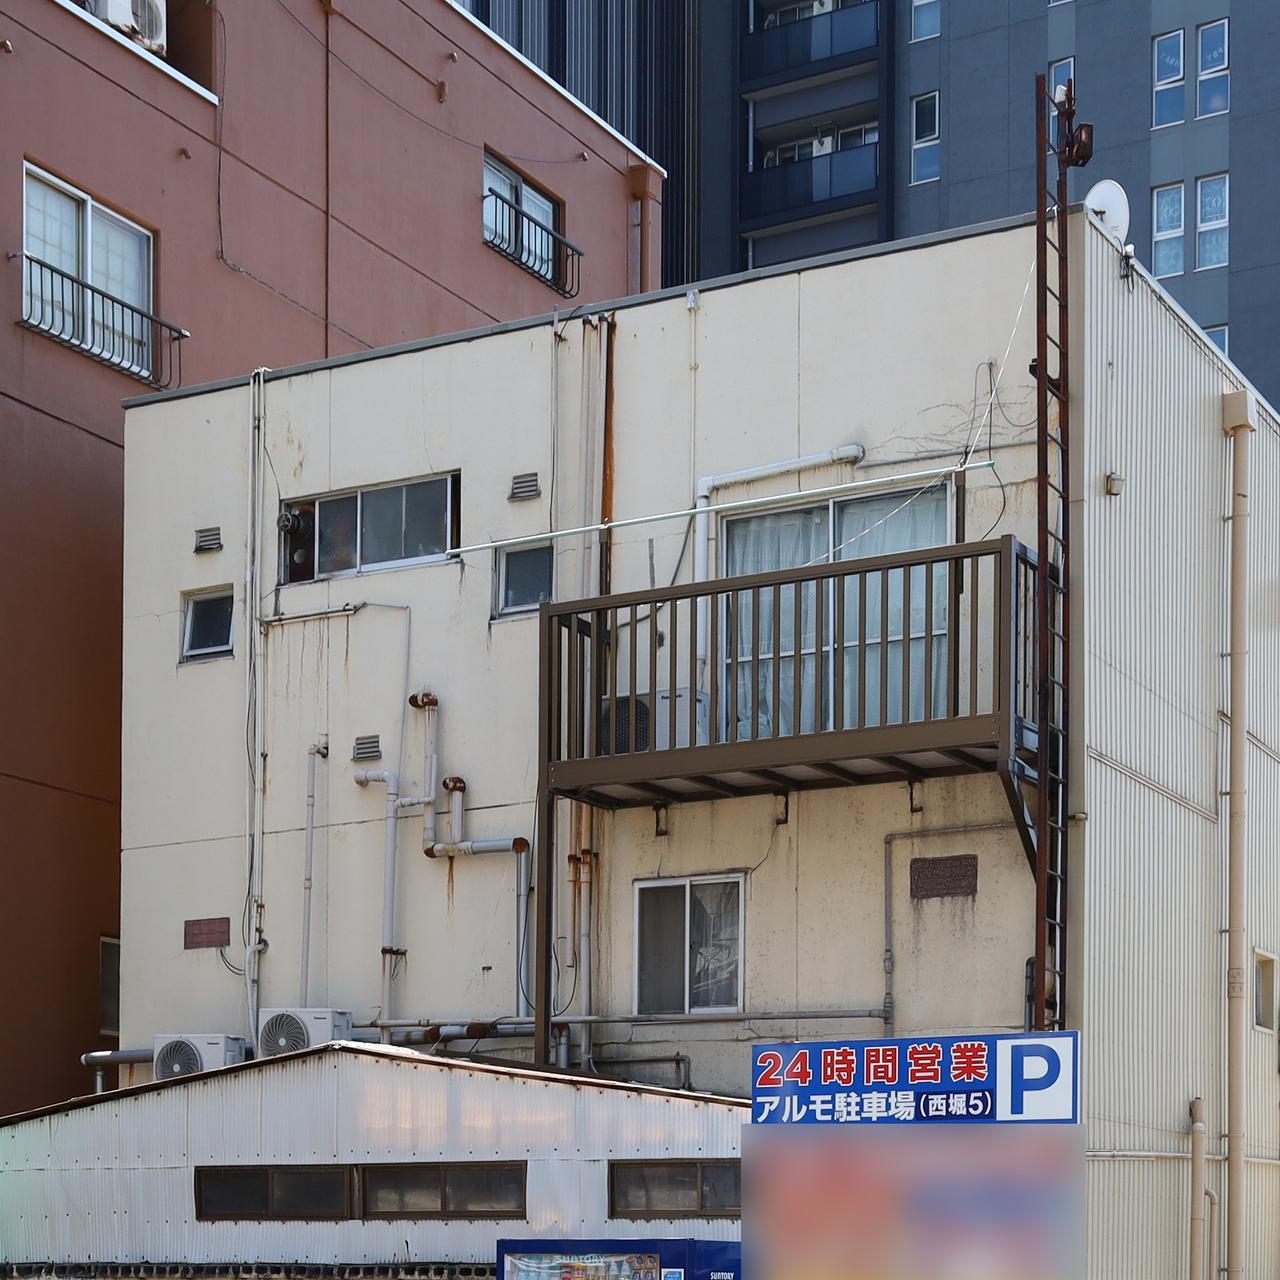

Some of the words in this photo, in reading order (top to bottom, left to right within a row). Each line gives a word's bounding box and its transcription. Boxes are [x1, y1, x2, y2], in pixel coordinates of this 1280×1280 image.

[756, 1041, 989, 1088] 24時間営業
[1011, 1044, 1061, 1116] P
[710, 1271, 735, 1280] SUNTORY
